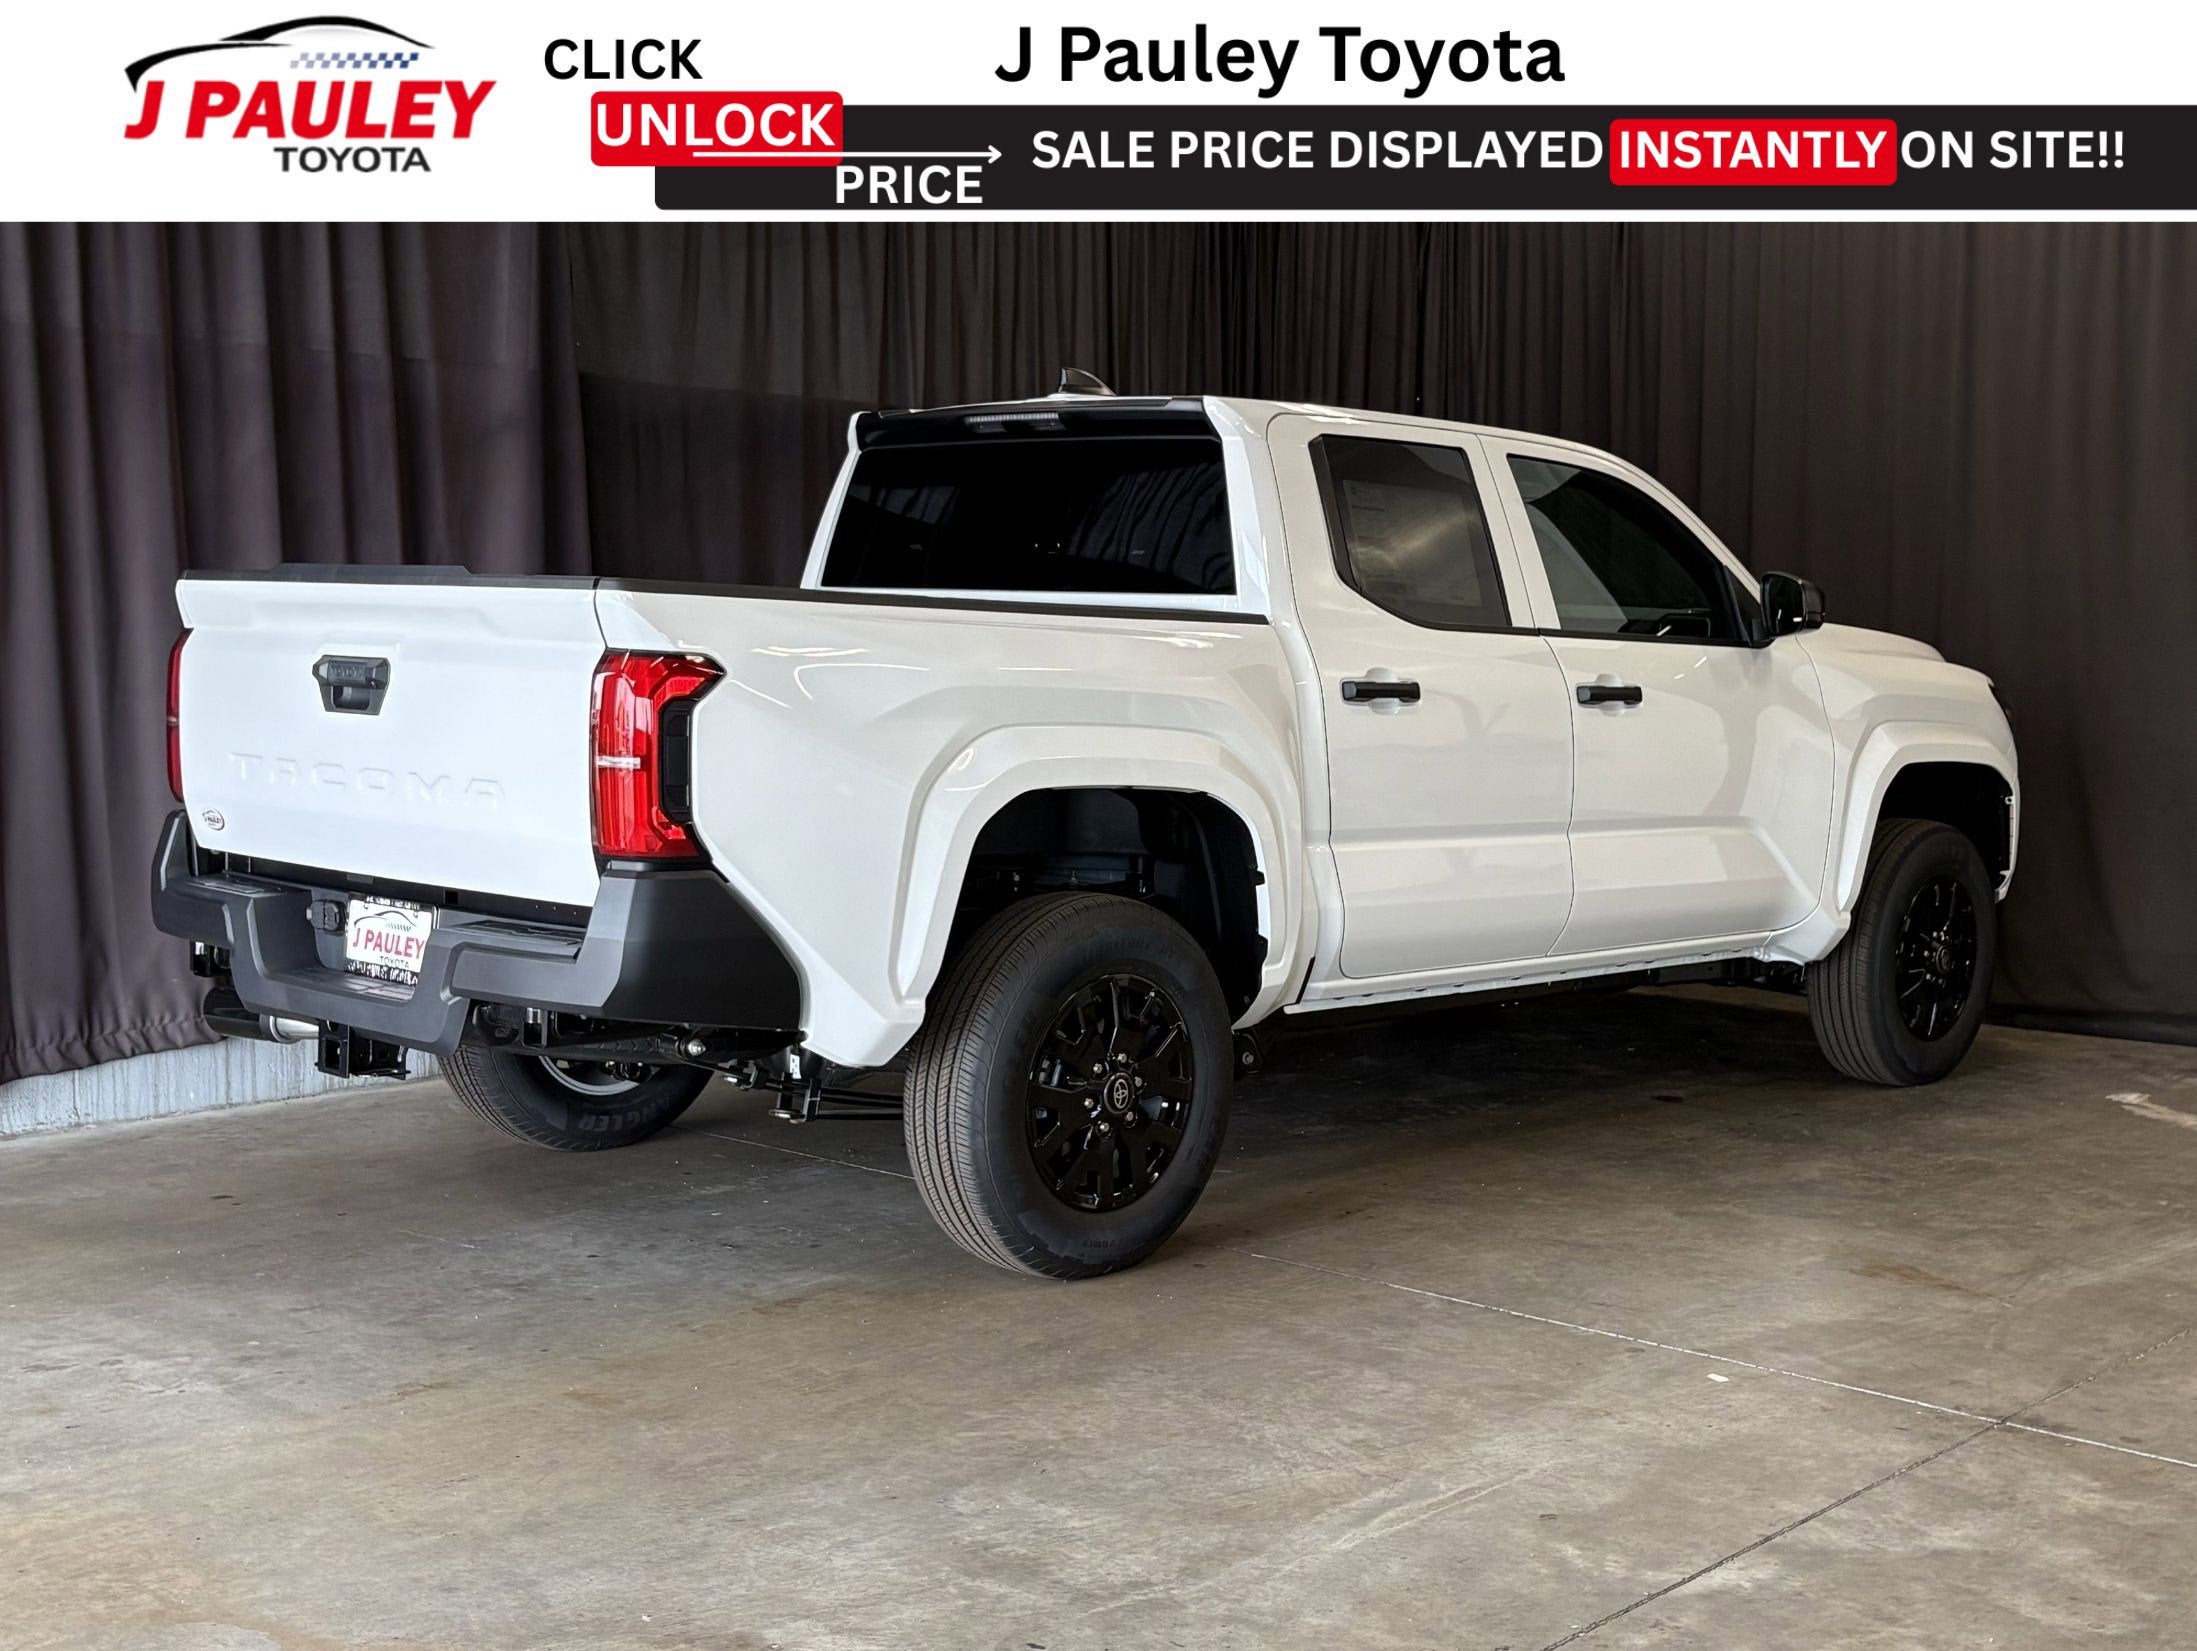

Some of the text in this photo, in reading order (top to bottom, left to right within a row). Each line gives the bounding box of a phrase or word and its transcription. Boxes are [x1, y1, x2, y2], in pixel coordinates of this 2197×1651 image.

[228, 751, 505, 807] TACOMA
[352, 927, 424, 960] J PAULEY
[379, 955, 410, 968] TOYOTA
